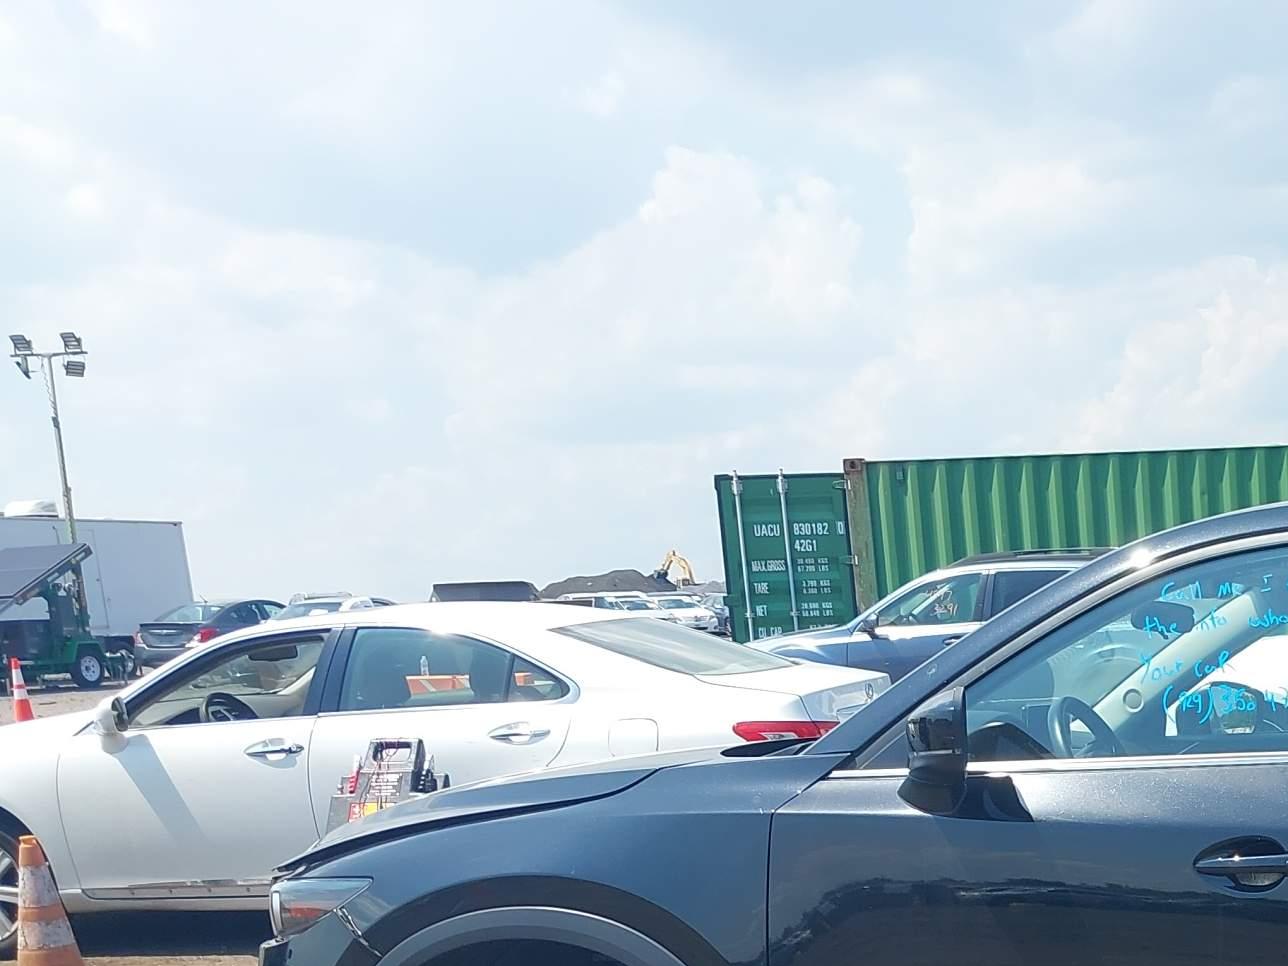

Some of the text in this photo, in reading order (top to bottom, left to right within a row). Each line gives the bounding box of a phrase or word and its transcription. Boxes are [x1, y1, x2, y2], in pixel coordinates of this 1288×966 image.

[753, 523, 780, 537] UACU
[793, 522, 829, 536] 830182
[794, 539, 817, 552] 42G1
[753, 582, 770, 594] TARE
[755, 605, 768, 617] NET
